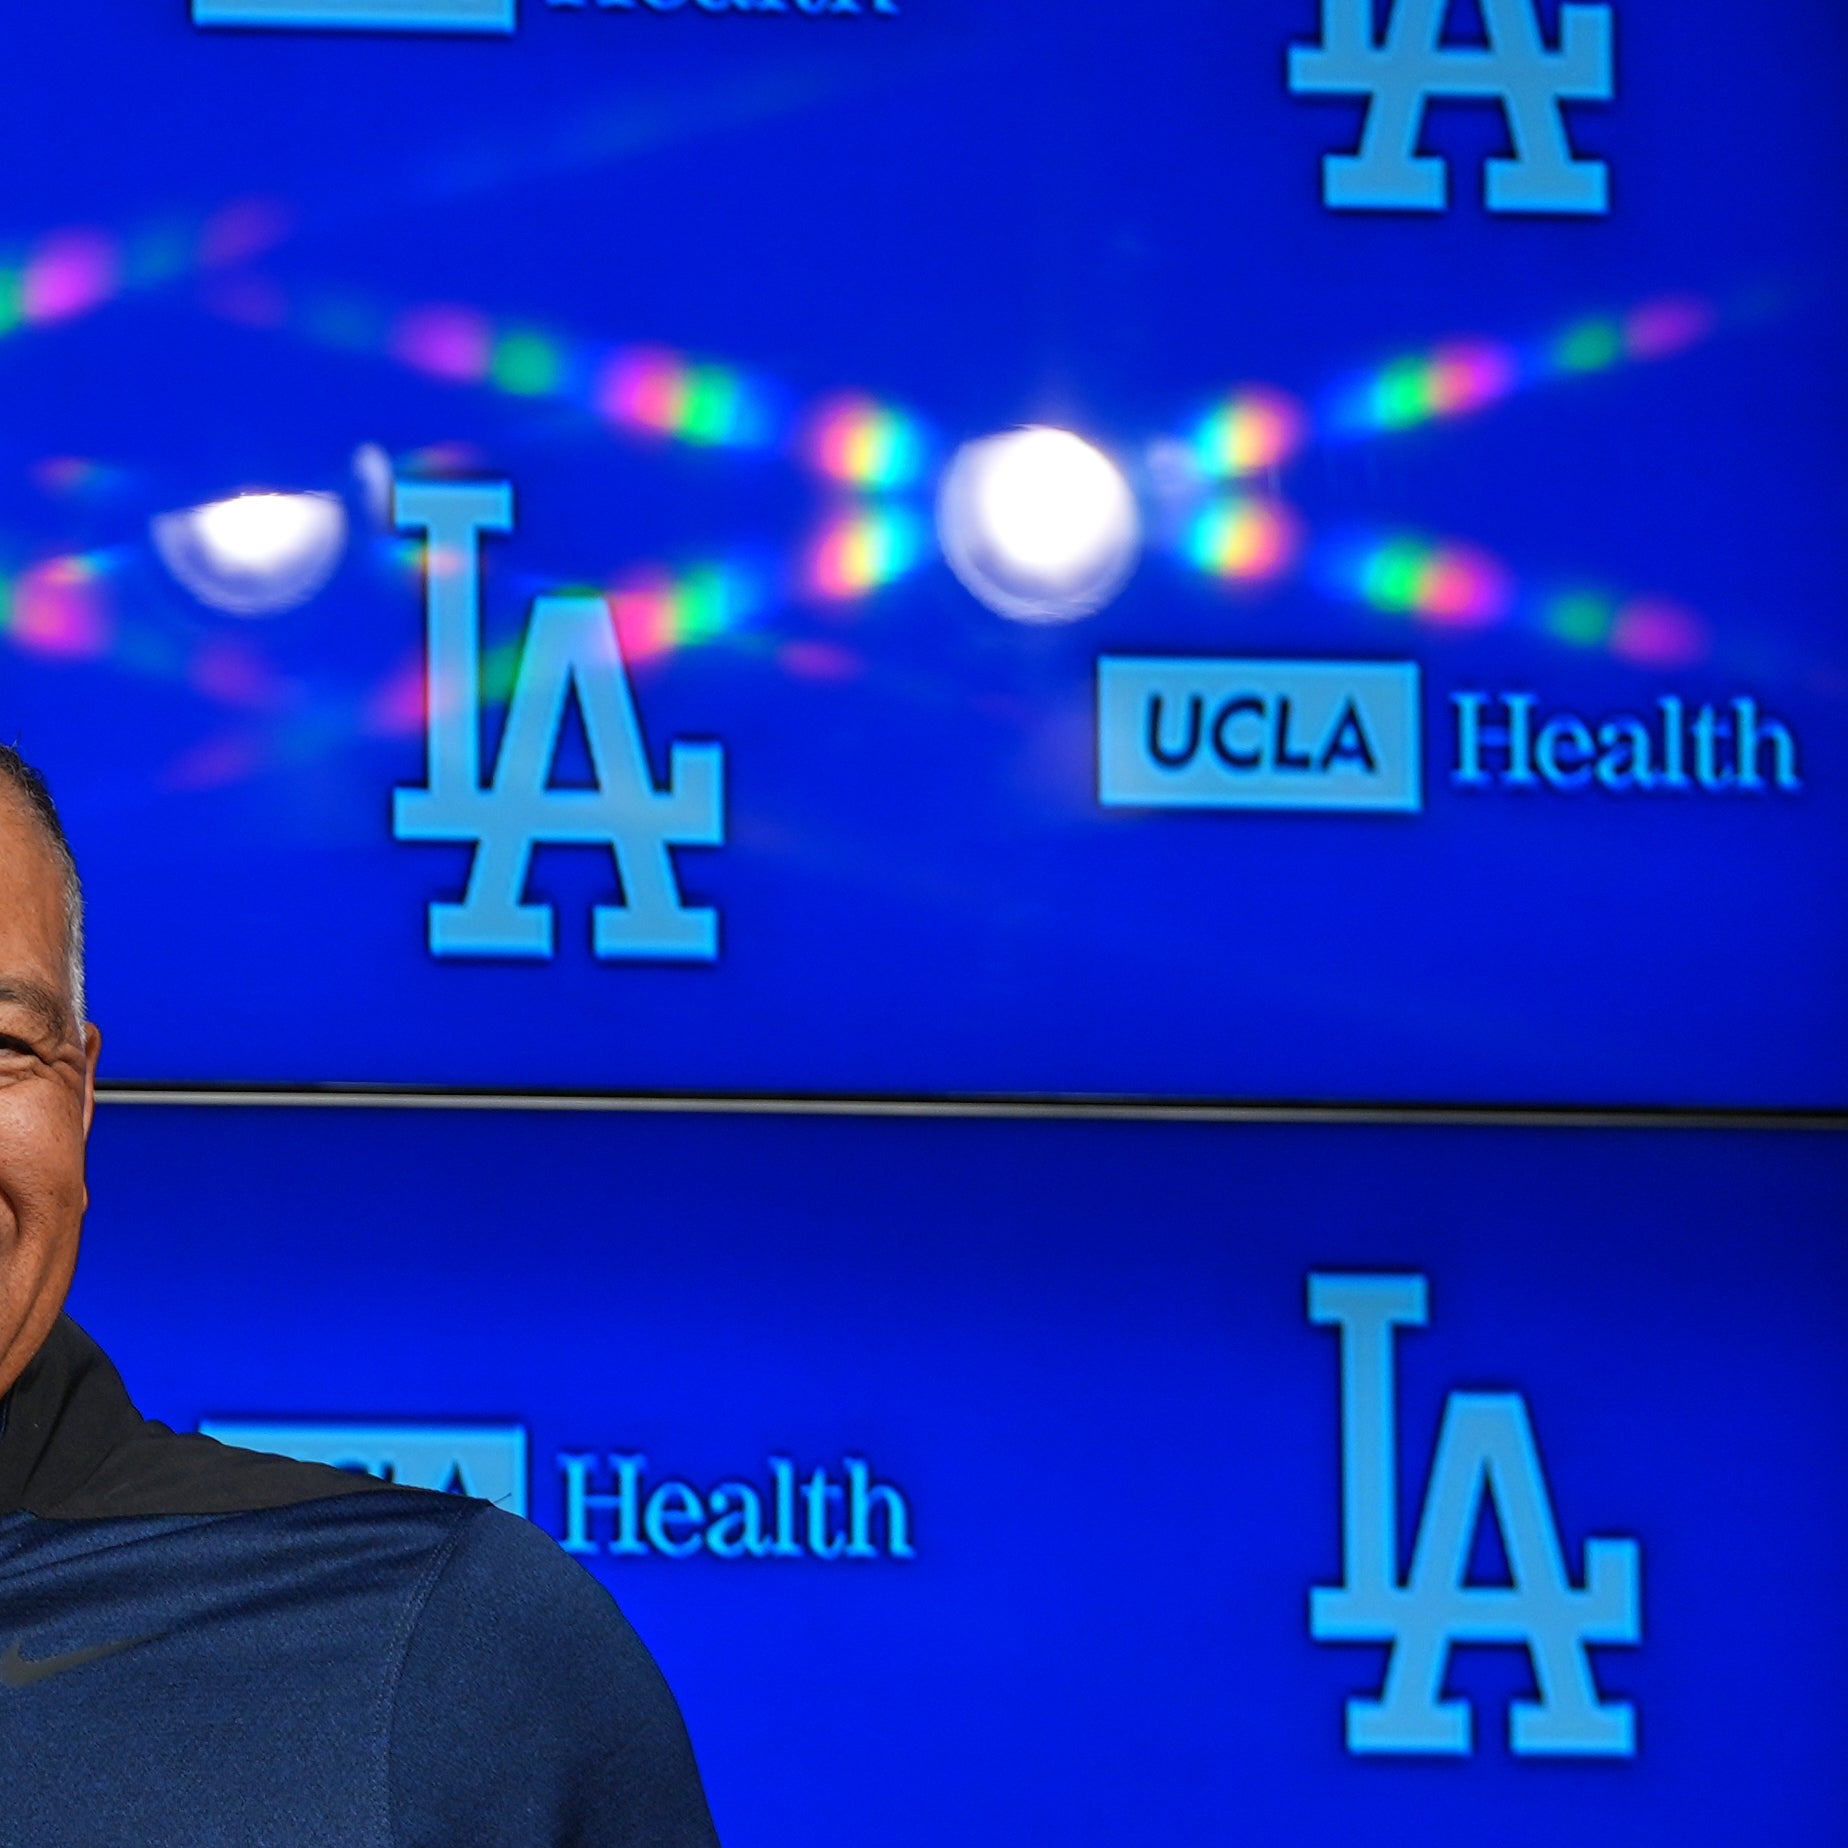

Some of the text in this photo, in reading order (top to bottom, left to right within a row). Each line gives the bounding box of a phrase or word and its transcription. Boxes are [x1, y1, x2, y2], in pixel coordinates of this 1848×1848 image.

[392, 478, 724, 961] LA
[1144, 690, 1802, 791] UCLA Health
[555, 1450, 914, 1561] Health
[1307, 1271, 1642, 1757] LA
